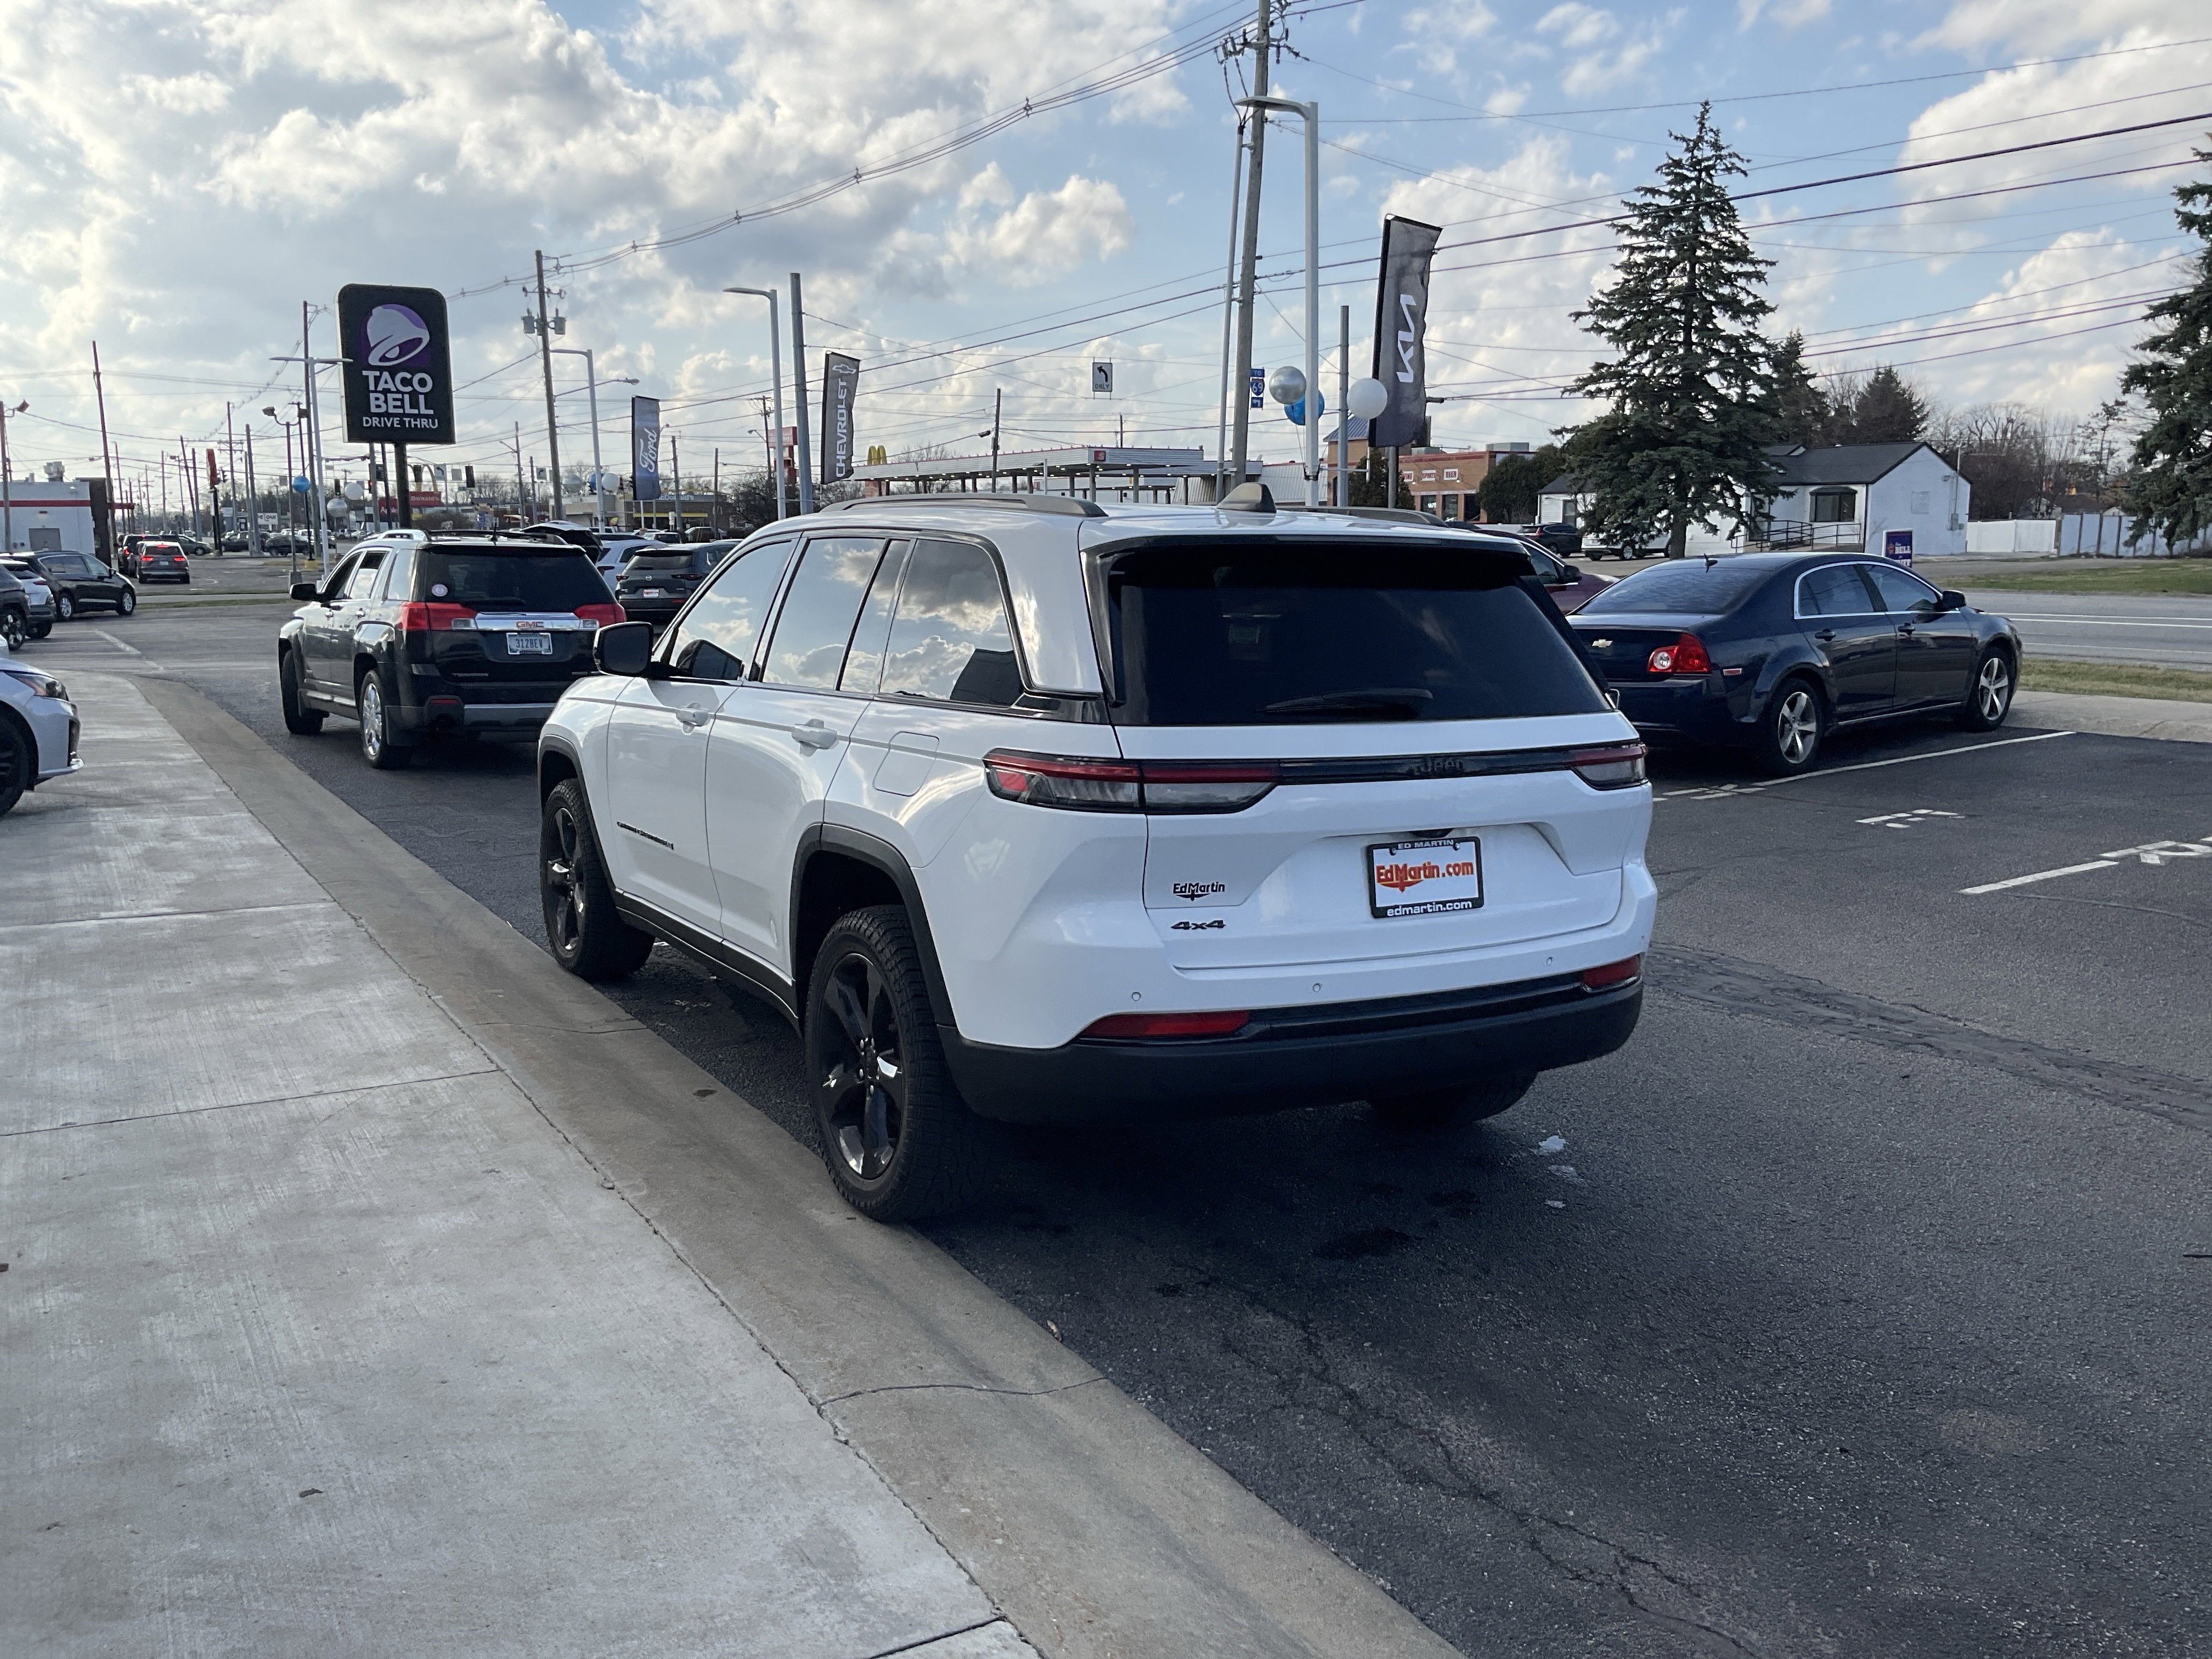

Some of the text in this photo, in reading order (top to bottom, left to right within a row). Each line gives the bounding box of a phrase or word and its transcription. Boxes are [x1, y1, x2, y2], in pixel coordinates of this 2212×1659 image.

[362, 370, 433, 393] TACO
[1252, 382, 1263, 392] 69
[370, 393, 434, 414] BELL
[363, 417, 438, 429] DRIVE THRU
[836, 378, 847, 477] CHEVROLET
[640, 428, 657, 472] Ford
[516, 639, 543, 648] 312BEV
[1414, 840, 1453, 848] MARTIN
[1376, 861, 1474, 882] EdMartin.com
[1173, 882, 1225, 894] EdMartin
[1387, 900, 1472, 917] edmartin.com
[1171, 920, 1226, 930] 4x4
